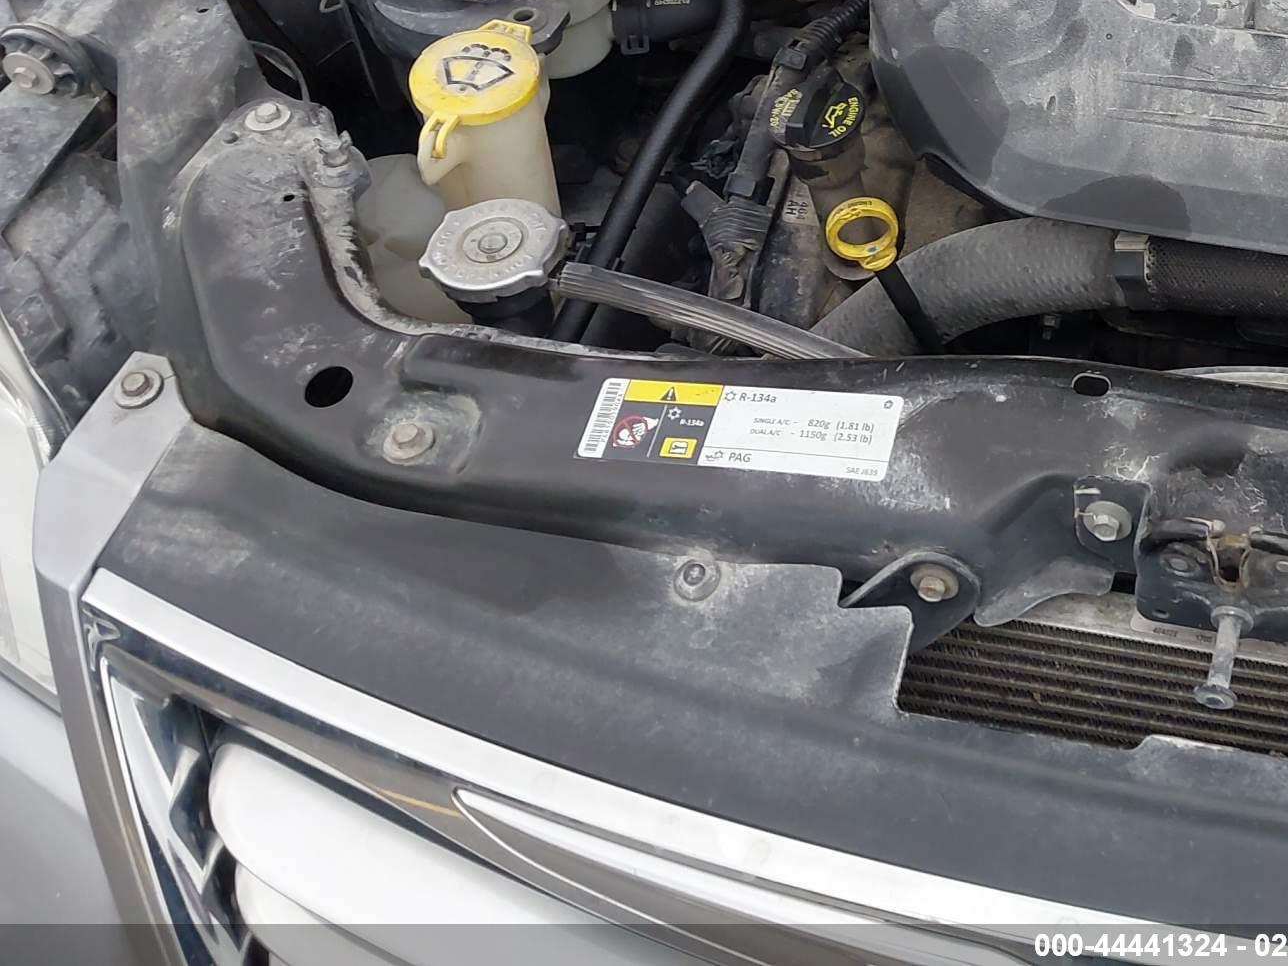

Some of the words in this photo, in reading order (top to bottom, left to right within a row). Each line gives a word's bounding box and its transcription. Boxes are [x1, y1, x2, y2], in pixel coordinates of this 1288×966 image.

[847, 97, 859, 126] ENGINE
[828, 125, 847, 137] OIL
[738, 393, 777, 403] R-134a
[806, 418, 831, 429] 820g
[835, 420, 859, 431] (1.81
[861, 422, 875, 432] lb)
[799, 430, 828, 440] 1150g
[833, 432, 857, 443] (2.53
[859, 434, 873, 444] lb)
[727, 452, 752, 462] PAG
